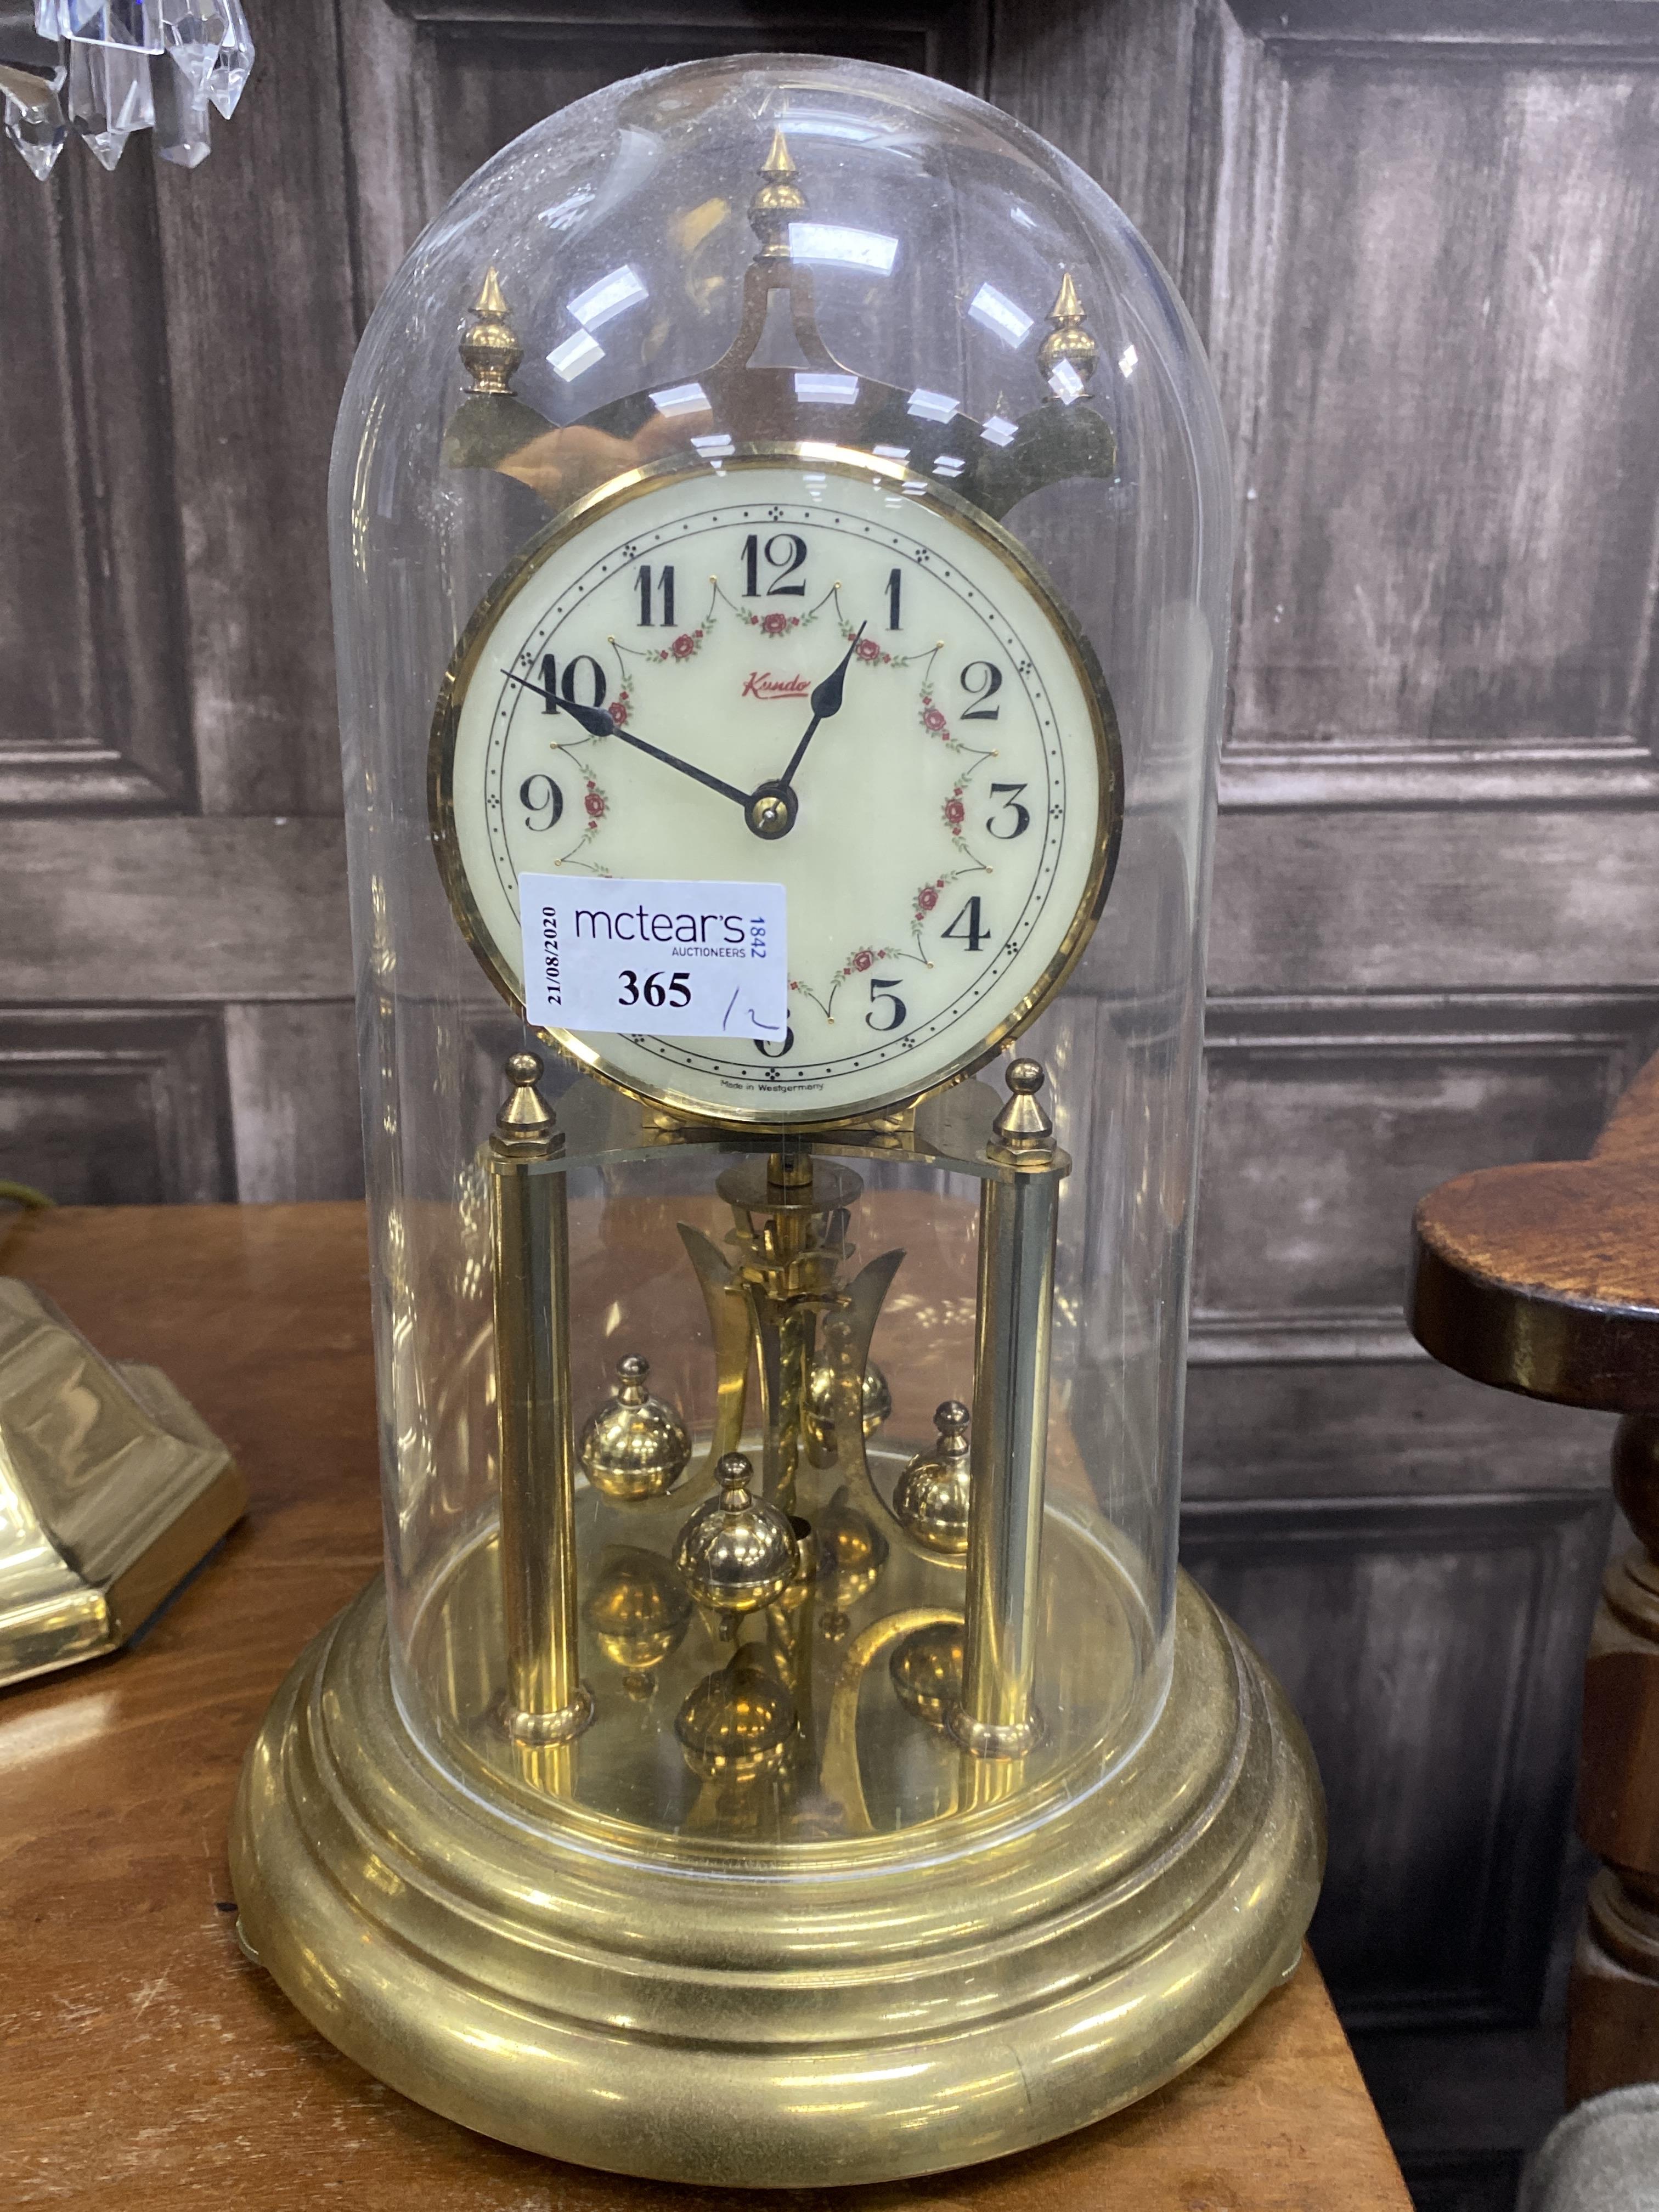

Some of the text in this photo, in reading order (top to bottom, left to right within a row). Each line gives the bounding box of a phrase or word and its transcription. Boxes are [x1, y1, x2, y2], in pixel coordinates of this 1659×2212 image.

[741, 533, 808, 597] 12
[637, 565, 678, 627] 11
[885, 568, 904, 630] 1
[539, 653, 607, 715] 10
[742, 672, 811, 699] Kundo
[960, 661, 1003, 720] 2
[520, 774, 563, 832] 9
[986, 783, 1031, 840] 3
[575, 905, 746, 943] mctear's
[749, 917, 766, 958] 1842
[940, 896, 991, 952] 4
[542, 906, 562, 1005] 21/08/2020
[672, 947, 746, 958] AUCTIONEERS
[618, 969, 692, 1008] 365
[866, 979, 908, 1031] 5
[720, 1080, 743, 1090] Made
